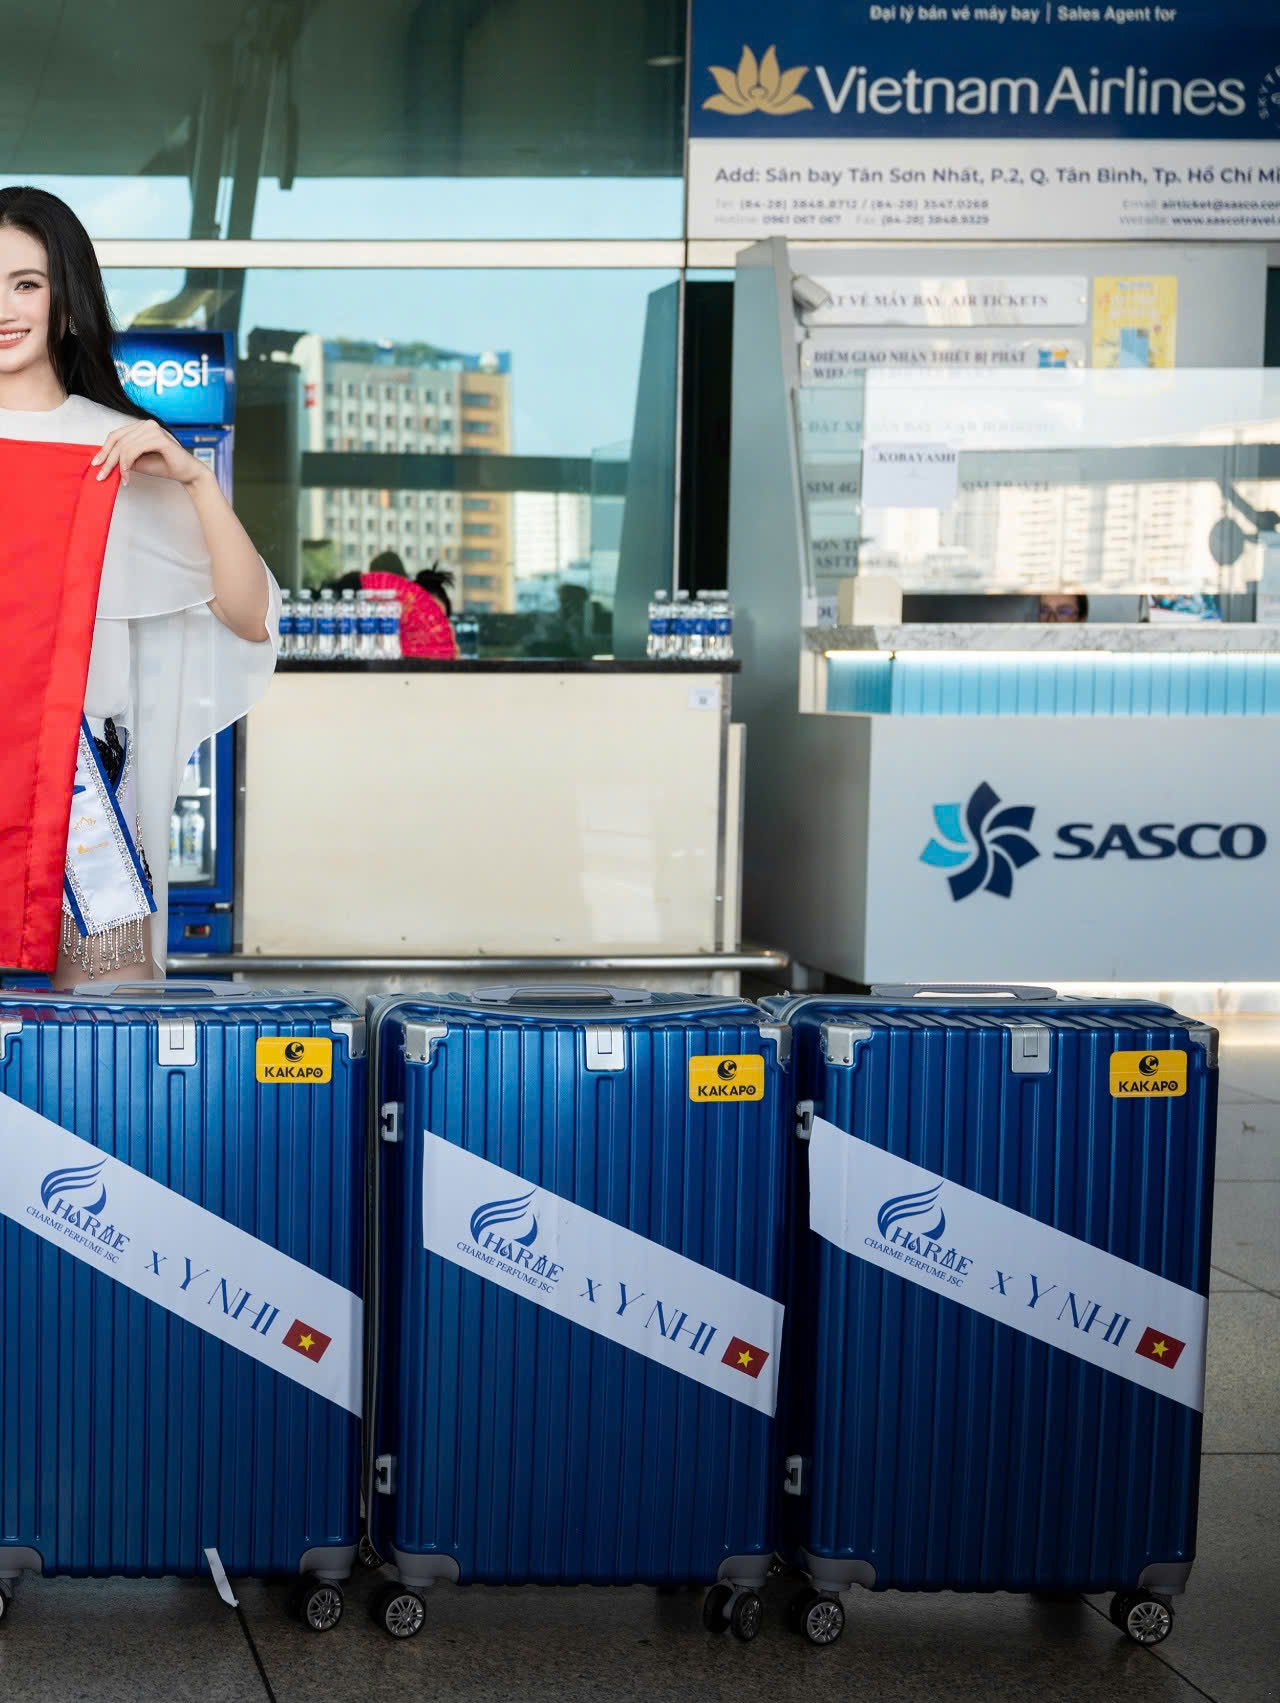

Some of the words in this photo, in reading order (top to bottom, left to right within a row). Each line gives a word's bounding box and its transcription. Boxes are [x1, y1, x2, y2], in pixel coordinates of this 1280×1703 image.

[1011, 5, 1040, 24] bay
[1057, 5, 1101, 21] Sales
[1104, 5, 1151, 24] Agent
[1154, 5, 1177, 21] for
[815, 66, 1038, 115] Vietnam
[1045, 65, 1246, 115] Airlines
[715, 168, 760, 183] Add:
[808, 168, 842, 187] bay
[991, 168, 1024, 185] P.2,
[1030, 168, 1049, 186] Q.
[1152, 168, 1181, 187] Tp.
[1053, 823, 1267, 860] SASCO
[264, 1066, 324, 1079] KAKAPO
[697, 1084, 757, 1097] KAKAPO
[1119, 1080, 1179, 1093] KAKAPO
[26, 1206, 64, 1231] CHARME
[64, 1227, 105, 1255] PERFUME
[103, 1248, 120, 1264] JSC
[456, 1241, 495, 1266] CHARME
[495, 1261, 538, 1287] PERFUME
[536, 1281, 554, 1294] JSC
[864, 1237, 904, 1260] CHARME
[904, 1254, 947, 1280] PERFUME
[946, 1275, 965, 1288] JSC
[207, 1278, 281, 1336] NHI
[644, 1300, 718, 1356] NHI
[1056, 1291, 1132, 1347] NHI
